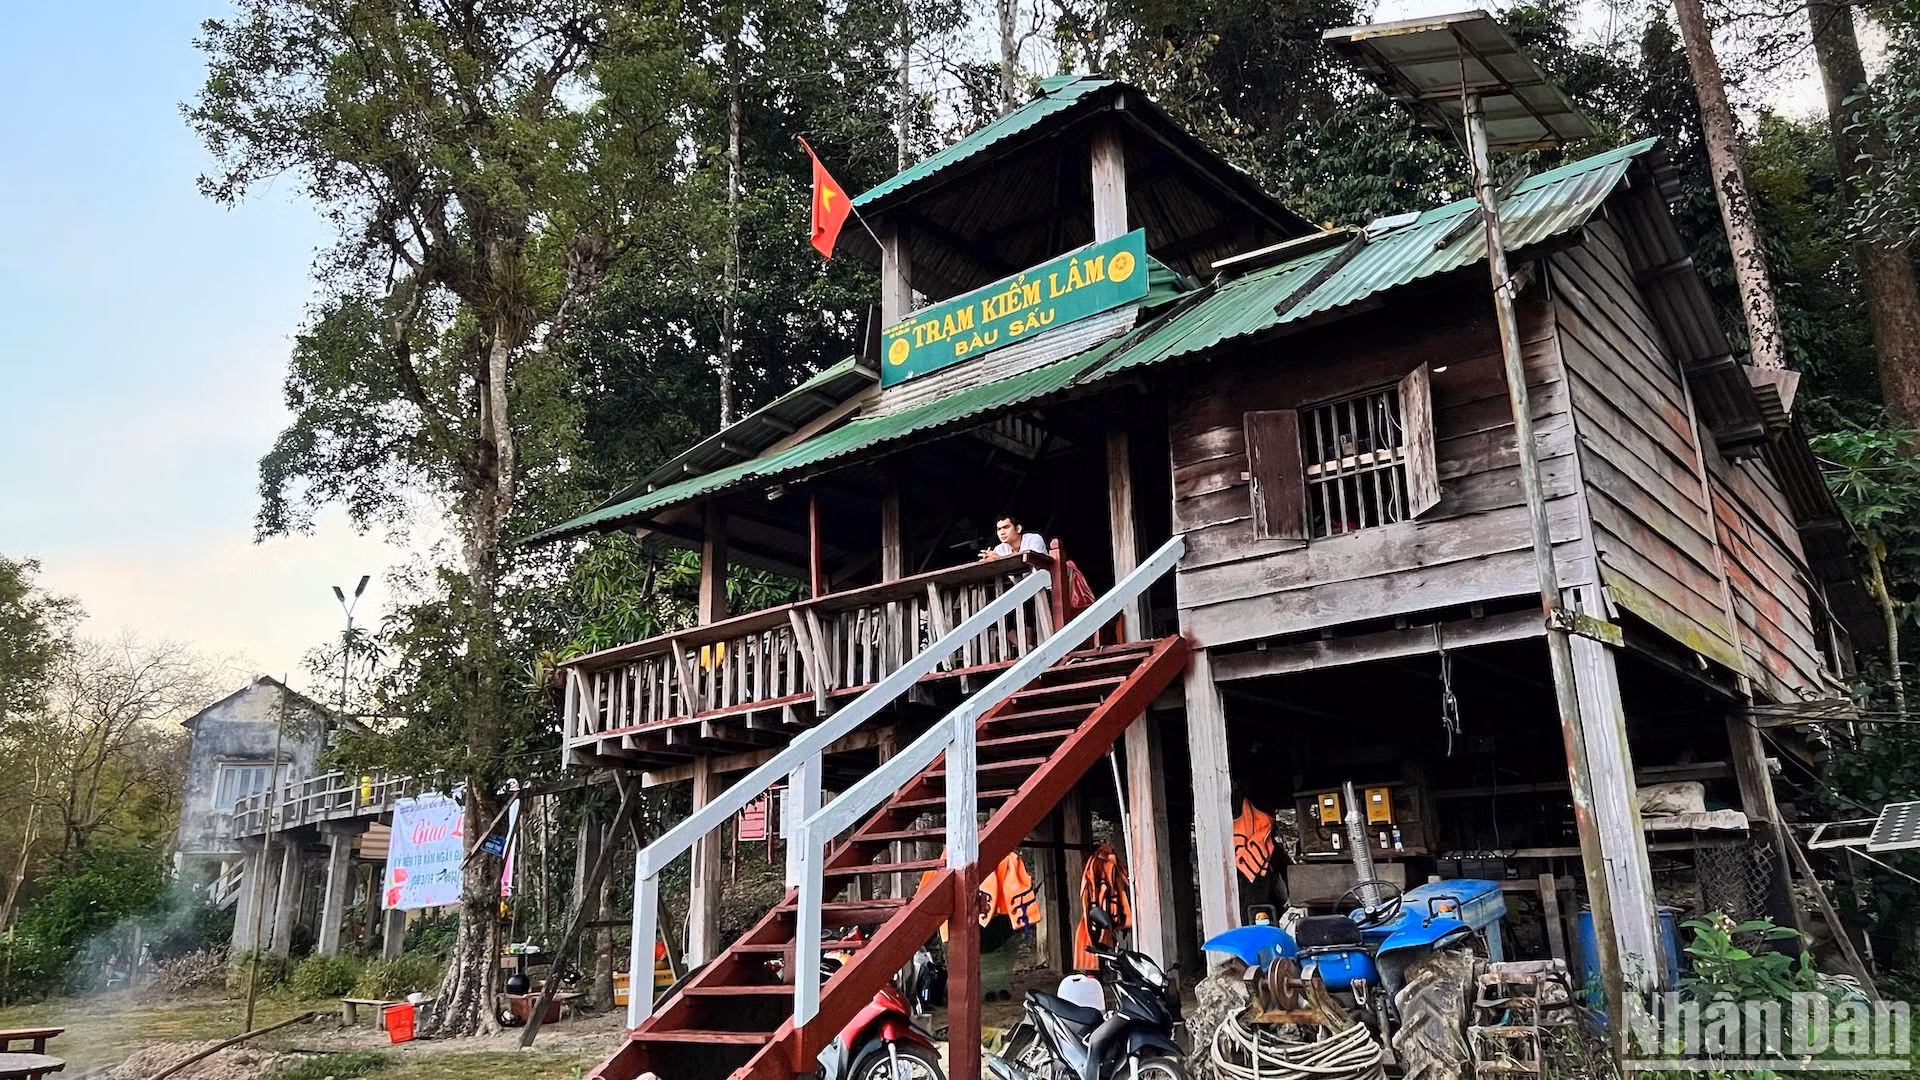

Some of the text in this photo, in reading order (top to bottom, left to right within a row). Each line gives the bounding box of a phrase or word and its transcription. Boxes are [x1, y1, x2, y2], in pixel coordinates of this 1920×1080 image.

[912, 305, 975, 348] TRẠM
[982, 274, 1041, 323] KIỂM
[1049, 255, 1105, 298] LÂM
[954, 308, 1056, 356] BÀU SẤU
[412, 819, 446, 847] Giao
